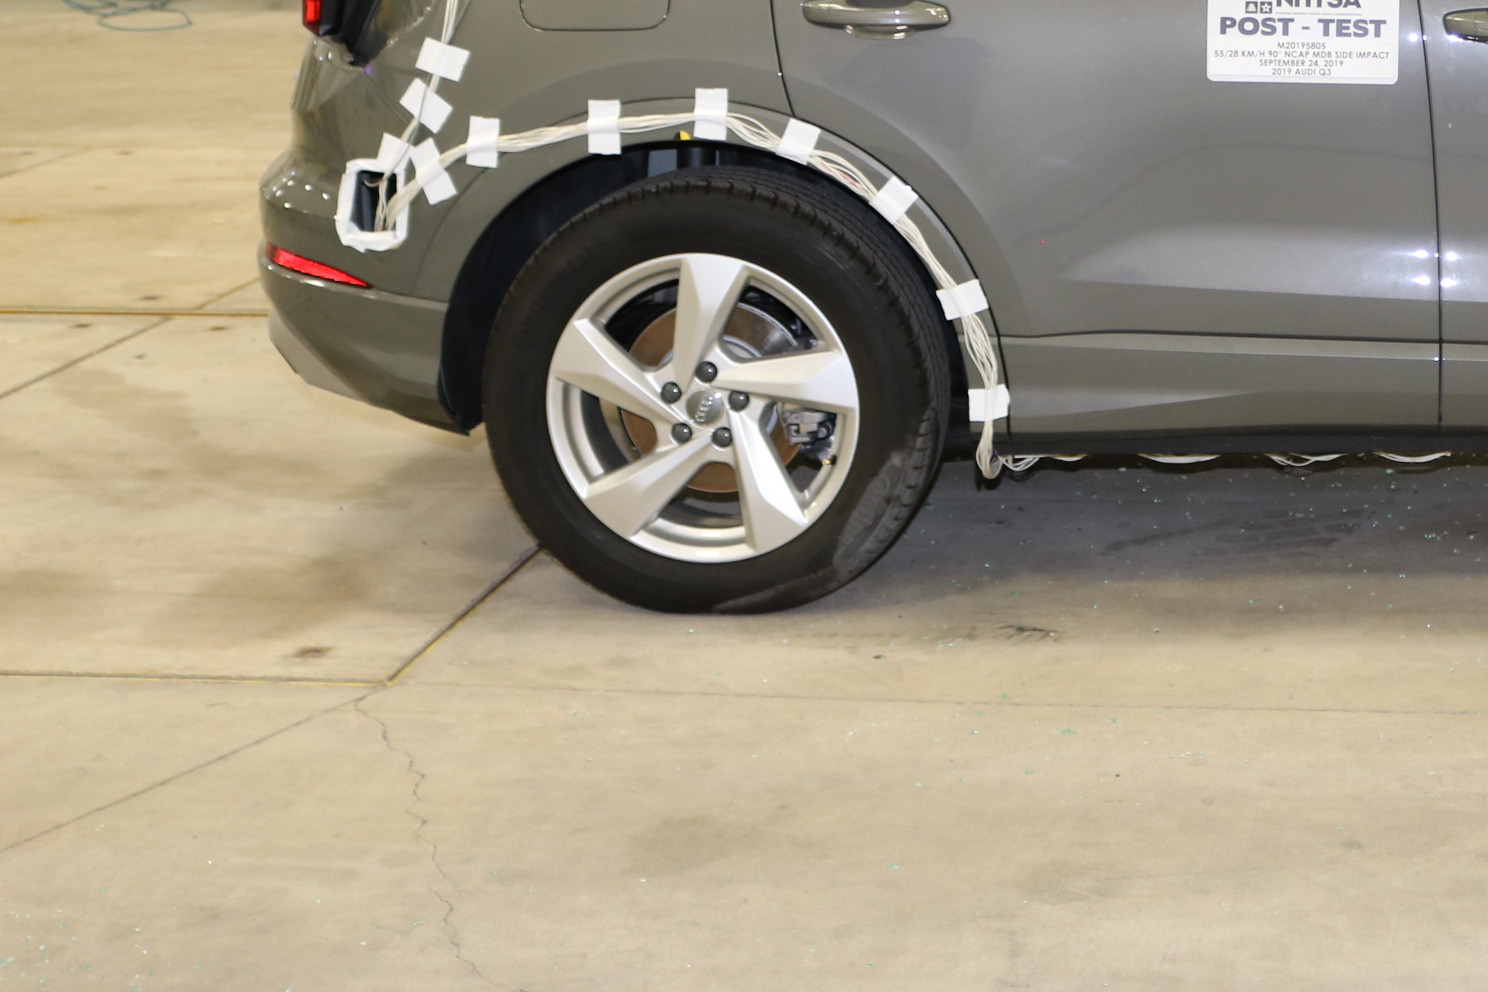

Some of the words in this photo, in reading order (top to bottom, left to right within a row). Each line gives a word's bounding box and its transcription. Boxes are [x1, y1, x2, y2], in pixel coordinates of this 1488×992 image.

[1220, 16, 1295, 36] POST
[1317, 18, 1387, 38] TEST
[1214, 50, 1239, 58] 55/28
[1241, 50, 1266, 58] KM/H
[1312, 51, 1332, 59] MDB
[1335, 51, 1353, 59] SIDE
[1259, 59, 1306, 67] SEPTEMBER
[1324, 60, 1344, 68] 2019
[1295, 68, 1316, 76] AUDI
[1319, 68, 1331, 76] Q3
